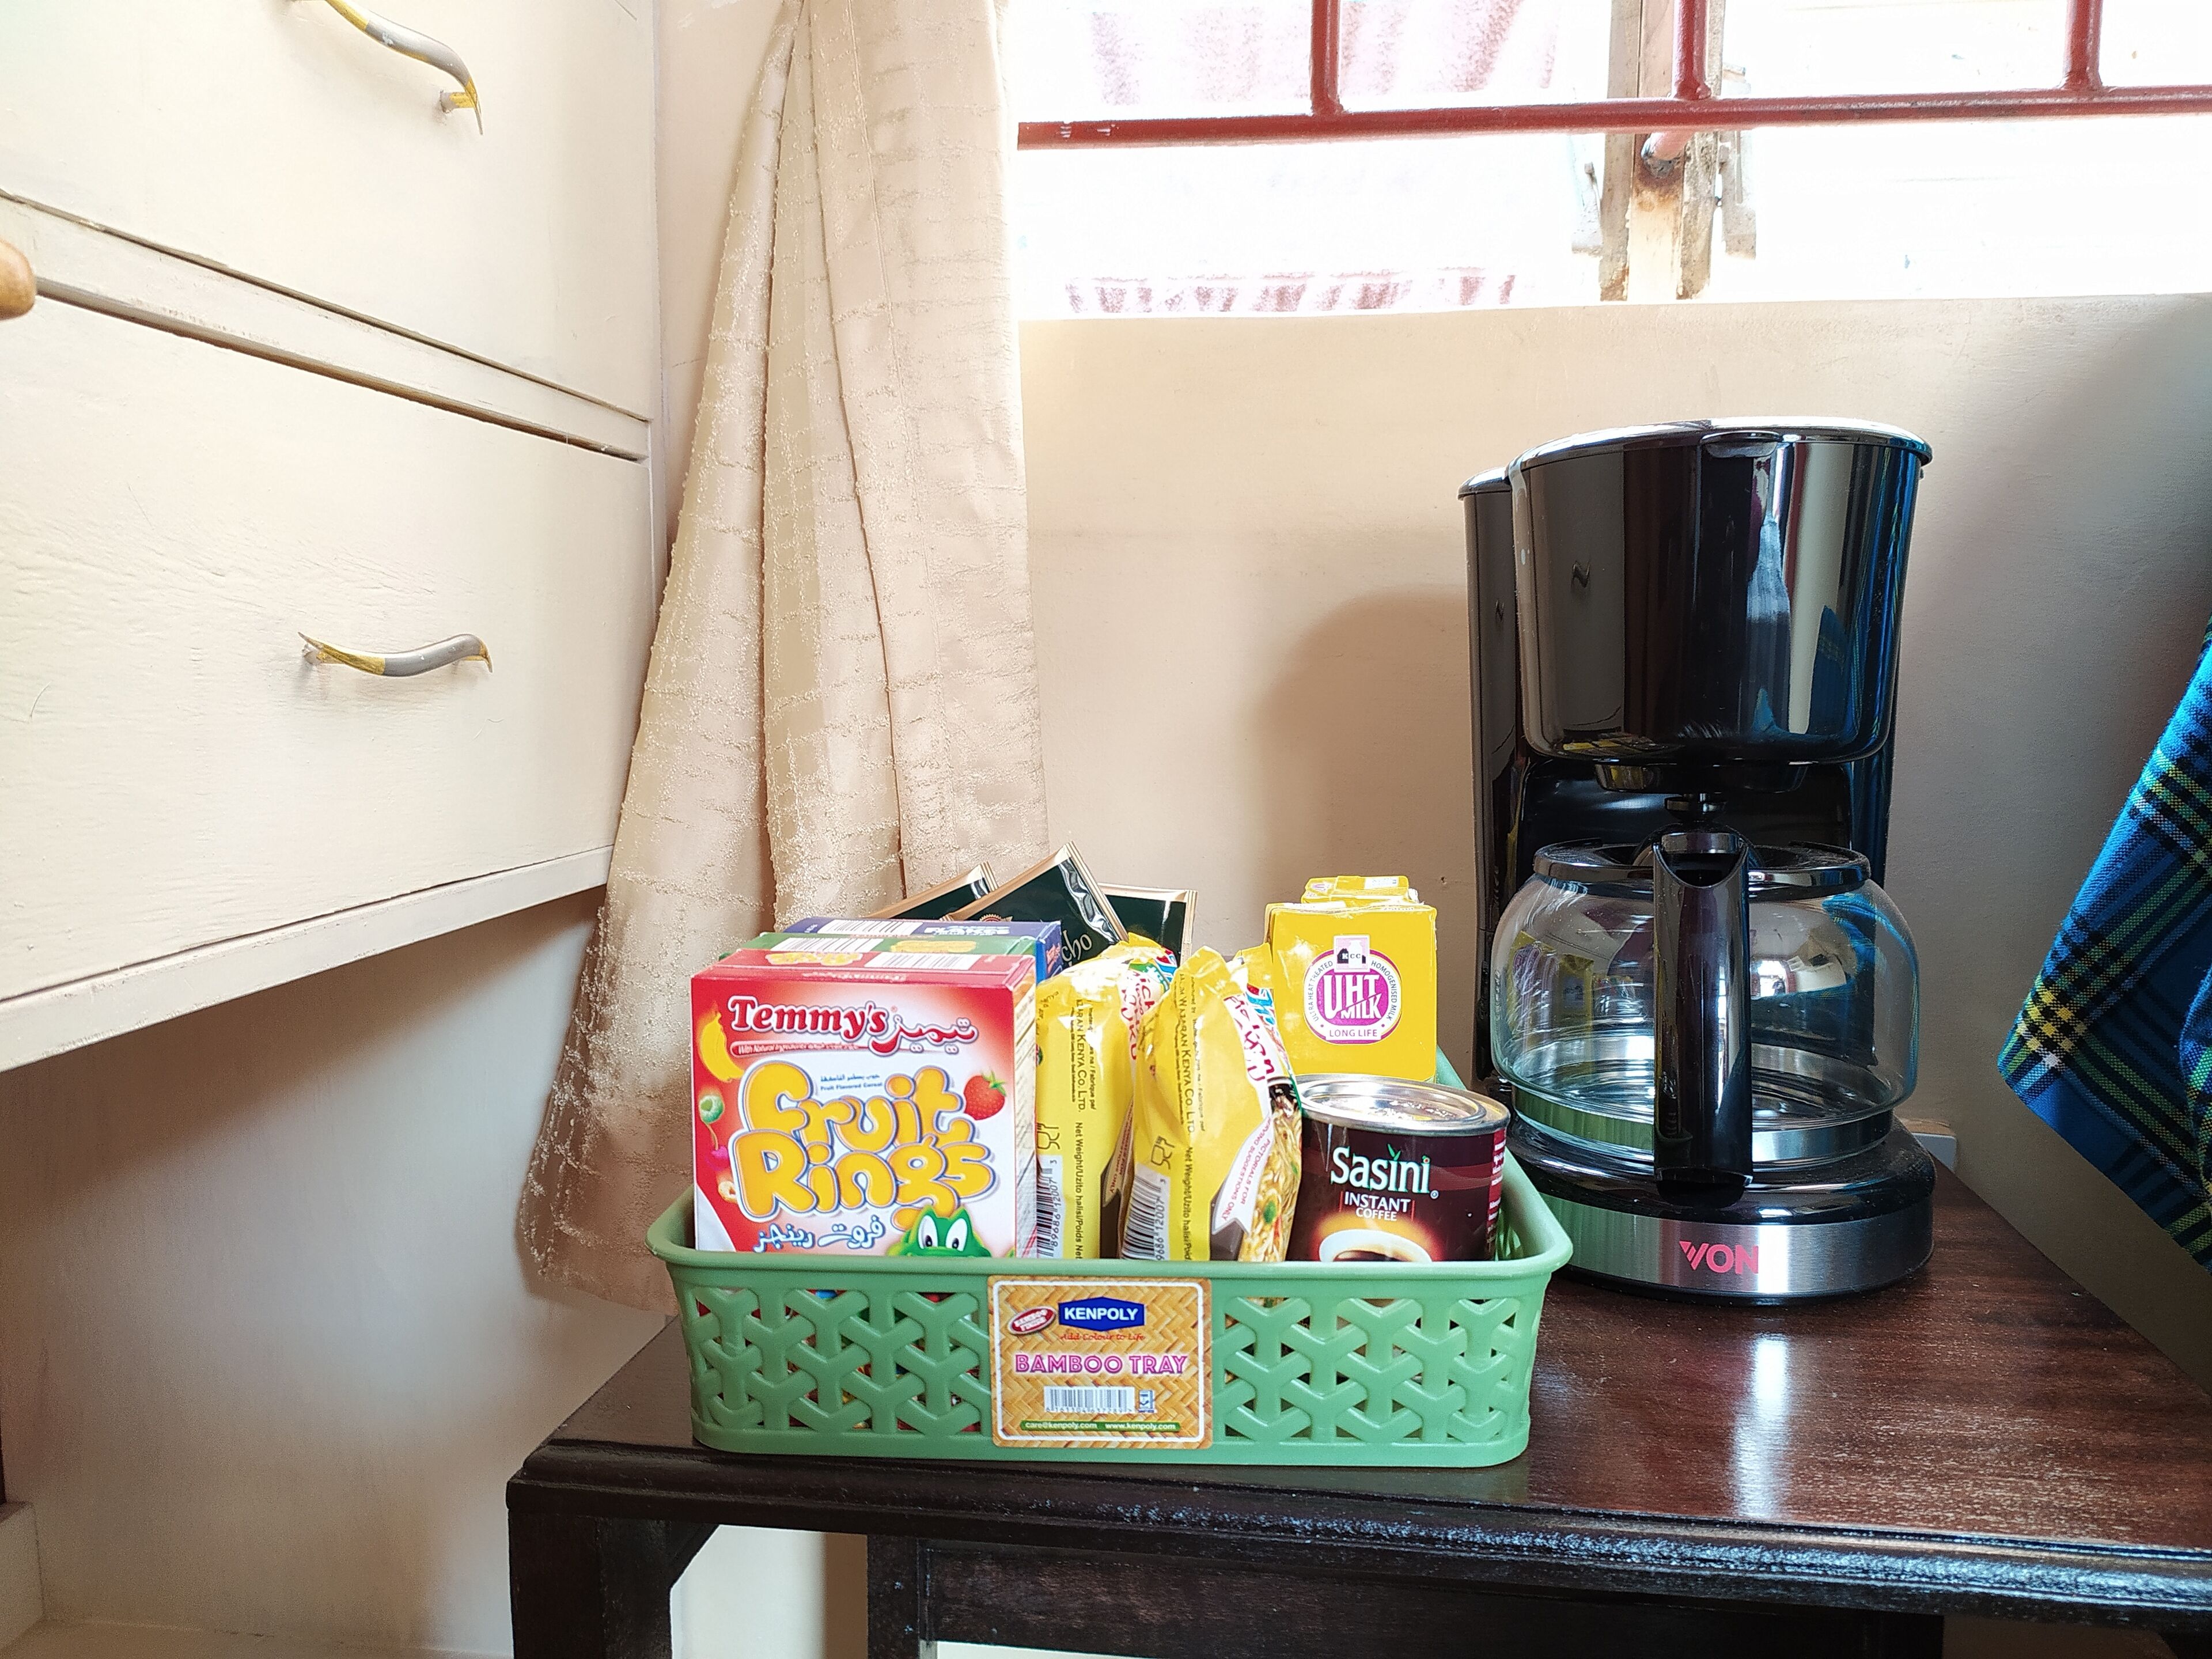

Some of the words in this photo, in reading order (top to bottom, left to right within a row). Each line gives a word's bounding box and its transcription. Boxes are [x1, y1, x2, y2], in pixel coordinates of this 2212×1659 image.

[1061, 930, 1092, 961] cho
[1310, 960, 1333, 982] TREATED
[1323, 974, 1380, 1020] UHT
[1341, 993, 1382, 1020] MILK
[1371, 960, 1397, 1003] HOMOGENISED
[1386, 1004, 1397, 1021] MILK
[728, 995, 888, 1041] Temmy's
[1308, 1002, 1319, 1021] ULTRA
[1077, 1034, 1086, 1068] KENYA
[1182, 1050, 1192, 1086] KENYA
[744, 1060, 975, 1152] Fruit
[1075, 1122, 1083, 1137] Net
[1074, 1139, 1084, 1194] Weight/Uzito
[1231, 1145, 1256, 1200] SUGGESTIONS
[1246, 1138, 1271, 1185] PICTORIALS
[1331, 1143, 1431, 1194] Sasini
[730, 1127, 993, 1230] Rings
[1221, 1201, 1235, 1221] ONLY
[1240, 1187, 1249, 1205] FOR
[1344, 1191, 1411, 1212] INSTANT
[1356, 1207, 1397, 1221] COFFEE
[1679, 1241, 1759, 1274] VON
[1064, 1306, 1139, 1321] KENPOLY
[1015, 1354, 1123, 1373] BAMBOO
[1129, 1355, 1188, 1374] TRAY
[1025, 1421, 1098, 1430] care@kenpoly.com
[1105, 1422, 1176, 1431] www.kenpoly.com
